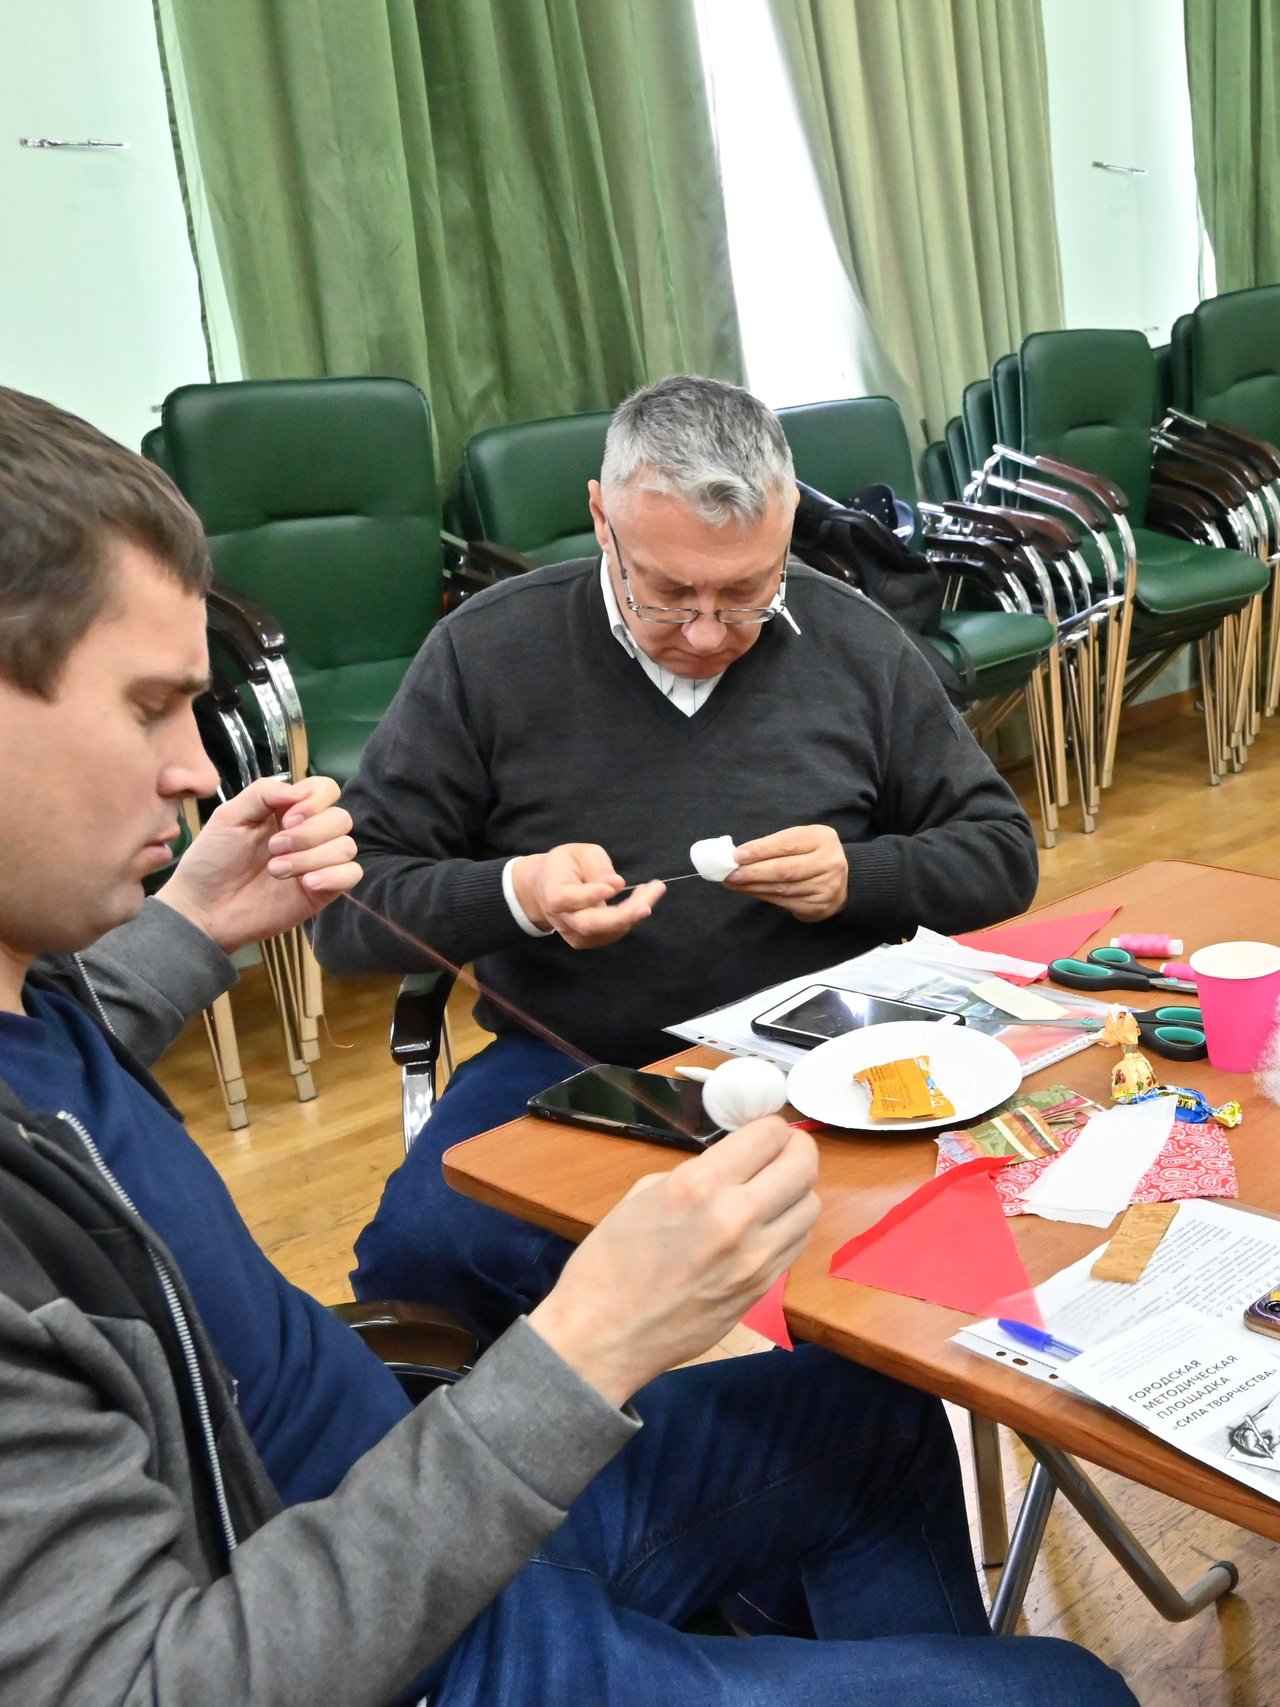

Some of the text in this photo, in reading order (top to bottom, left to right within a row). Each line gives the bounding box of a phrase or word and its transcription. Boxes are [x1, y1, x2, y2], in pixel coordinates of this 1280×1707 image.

[1128, 1359, 1202, 1403] ГОРОДСКАЯ
[1142, 1354, 1238, 1411] МЕТОДИЧЕСКАЯ
[1156, 1376, 1232, 1420] ПЛОЩАДКА
[1172, 1368, 1278, 1431] «СИЛА ТВОРЧЕСТВА»
